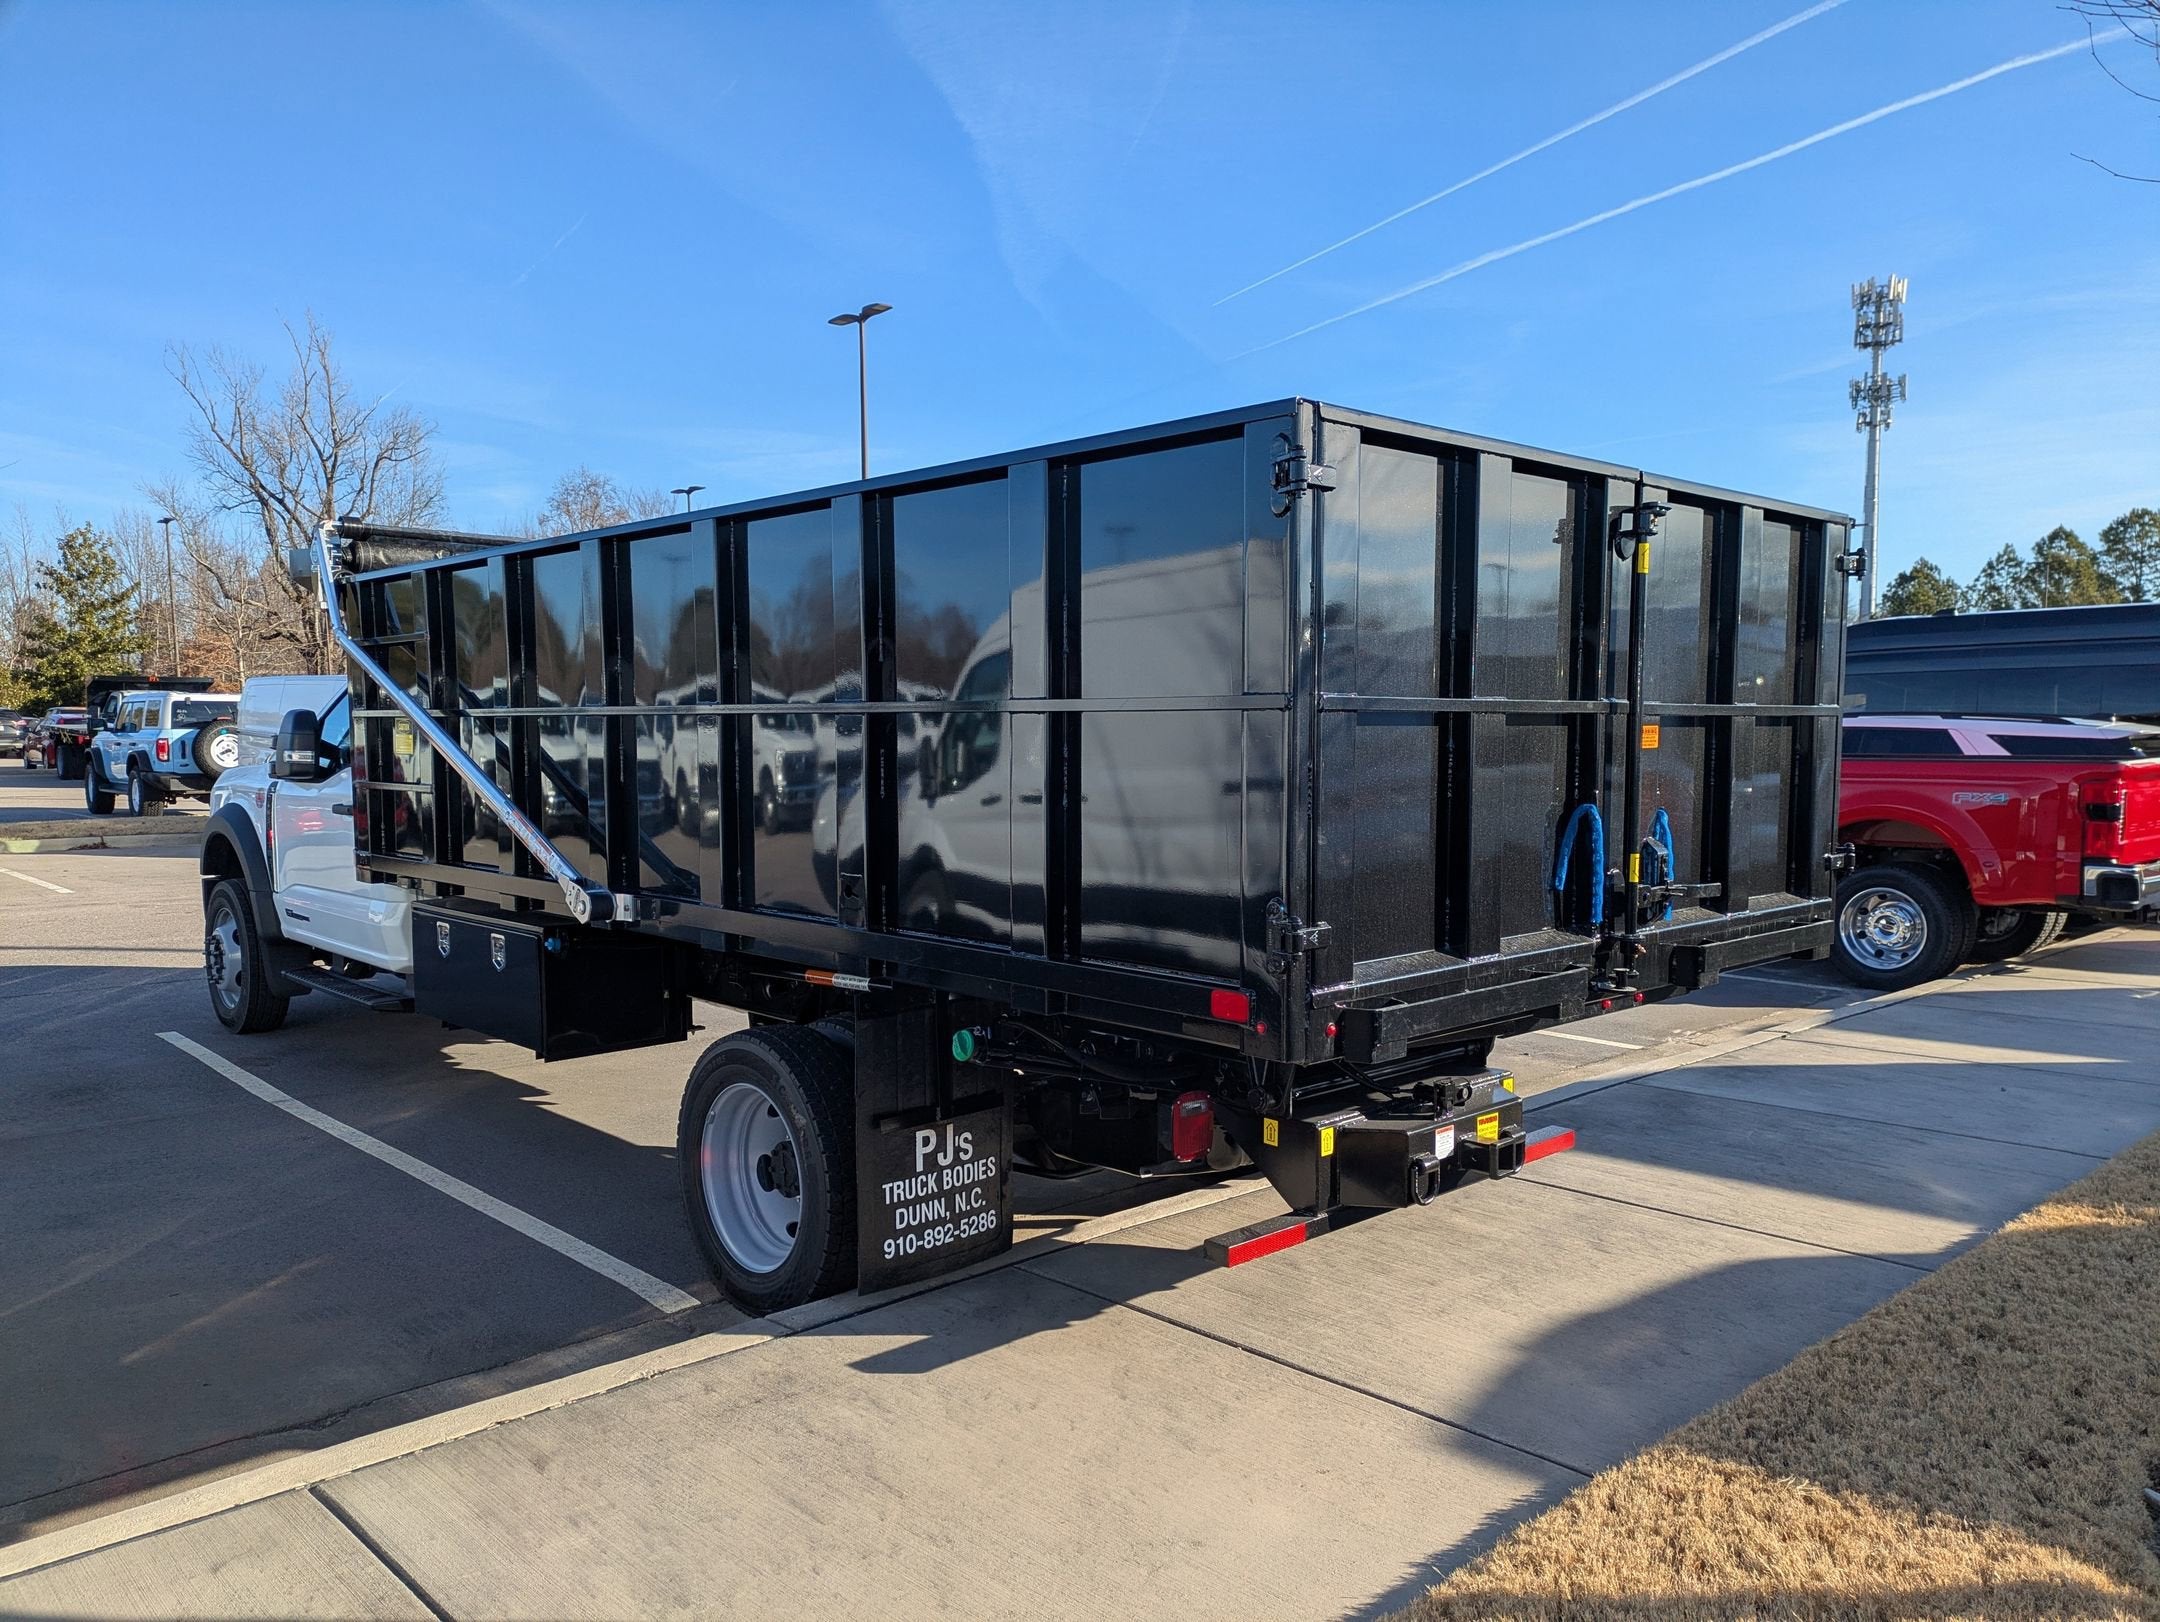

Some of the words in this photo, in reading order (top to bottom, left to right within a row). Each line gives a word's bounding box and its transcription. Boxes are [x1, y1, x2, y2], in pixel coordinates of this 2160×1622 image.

[1952, 791, 2008, 805] FX4
[882, 1171, 938, 1205] TRUCK
[943, 1156, 996, 1190] BODIES
[895, 1197, 950, 1230] DUNN,
[955, 1187, 986, 1214] N.C.
[883, 1209, 997, 1260] 910-892-5286
